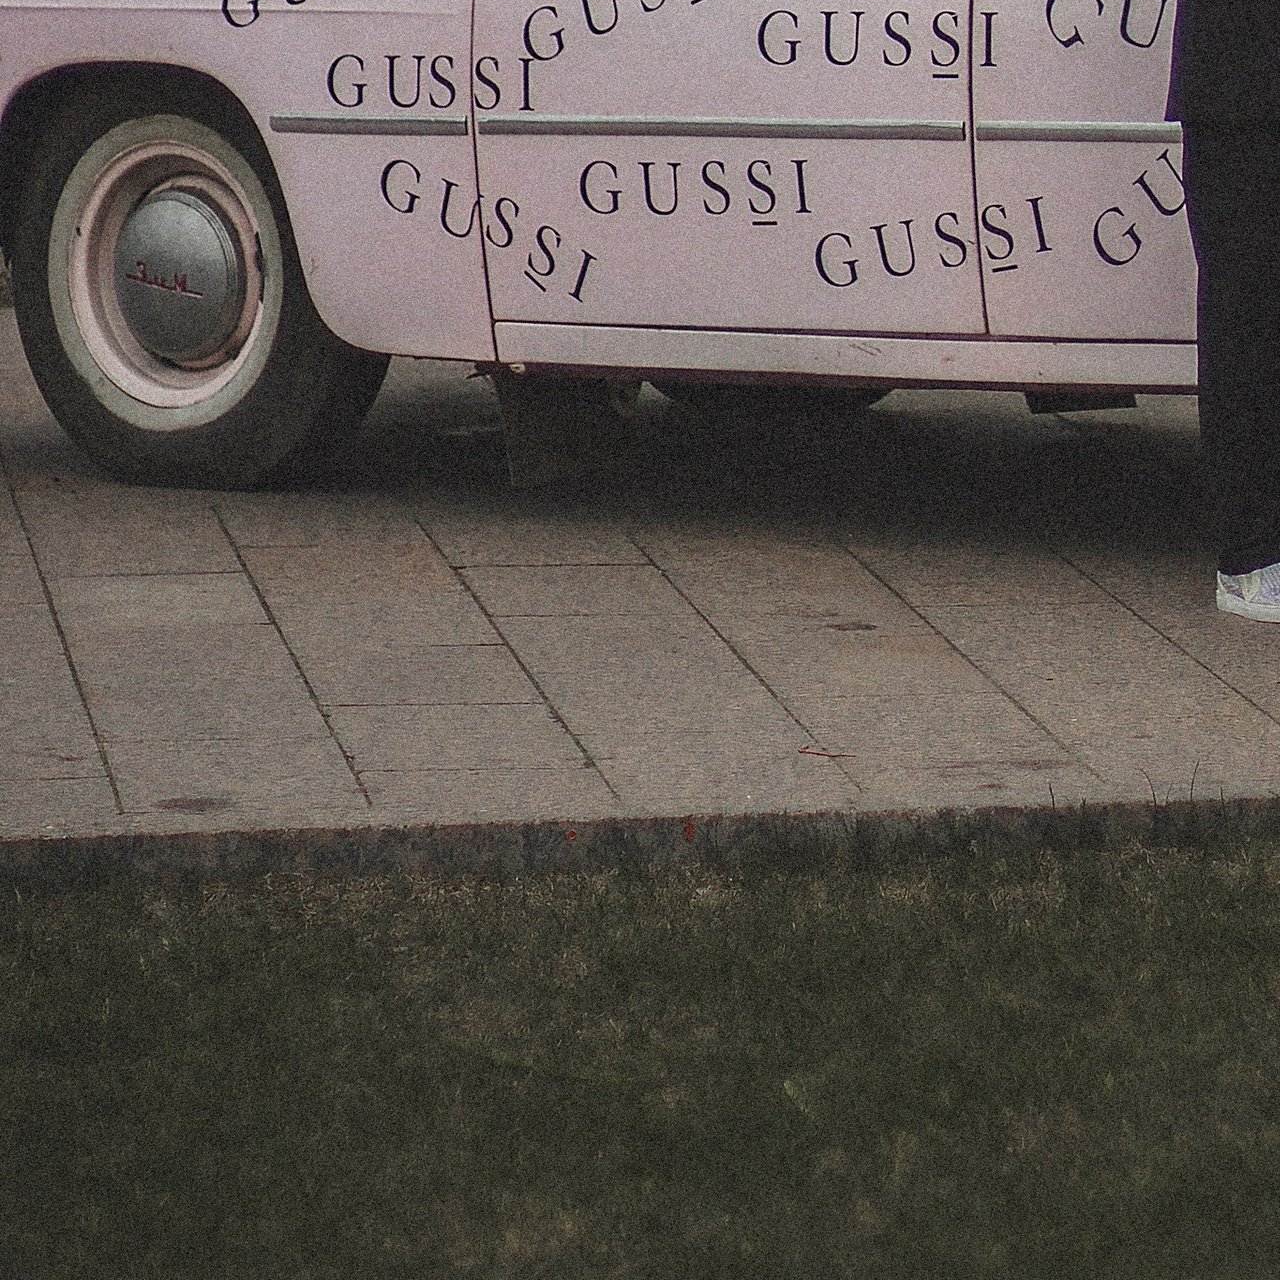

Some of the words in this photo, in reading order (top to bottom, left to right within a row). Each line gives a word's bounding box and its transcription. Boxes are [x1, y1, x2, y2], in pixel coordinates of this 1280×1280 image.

[757, 10, 998, 78] GUSSI
[327, 53, 533, 111] GUSSI
[579, 159, 812, 226] GUSSI
[381, 160, 596, 301] GUSSI
[815, 195, 1052, 287] GUSSI
